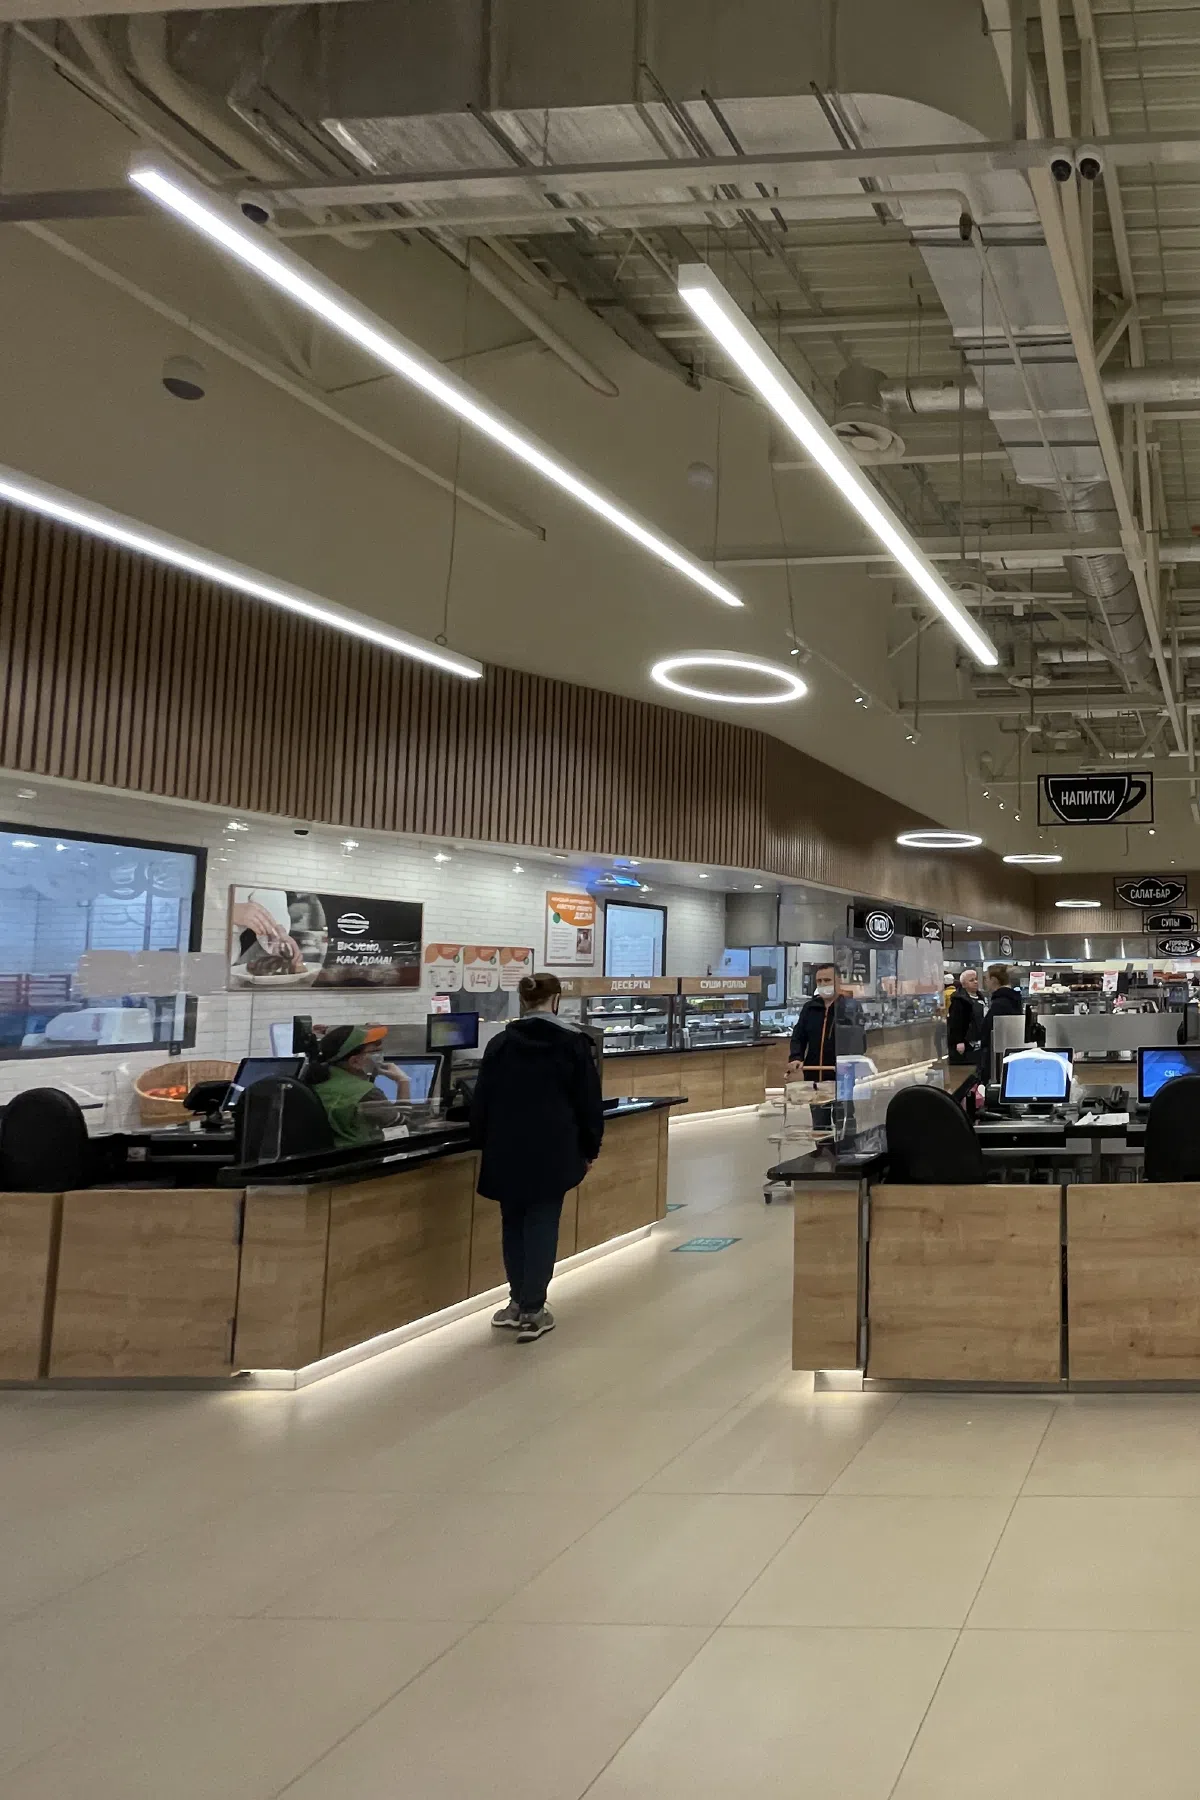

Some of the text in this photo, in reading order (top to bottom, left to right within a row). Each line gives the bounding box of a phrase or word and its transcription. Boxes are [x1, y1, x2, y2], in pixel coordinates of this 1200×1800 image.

[1061, 790, 1116, 806] НАПИТКИ
[1130, 888, 1171, 899] САЛАТ-БАР
[1161, 918, 1180, 927] СУПЫ
[336, 955, 393, 966] КАК ДОМА!
[611, 980, 651, 991] ДЕСЕРТЫ
[700, 980, 721, 989] СУШИ
